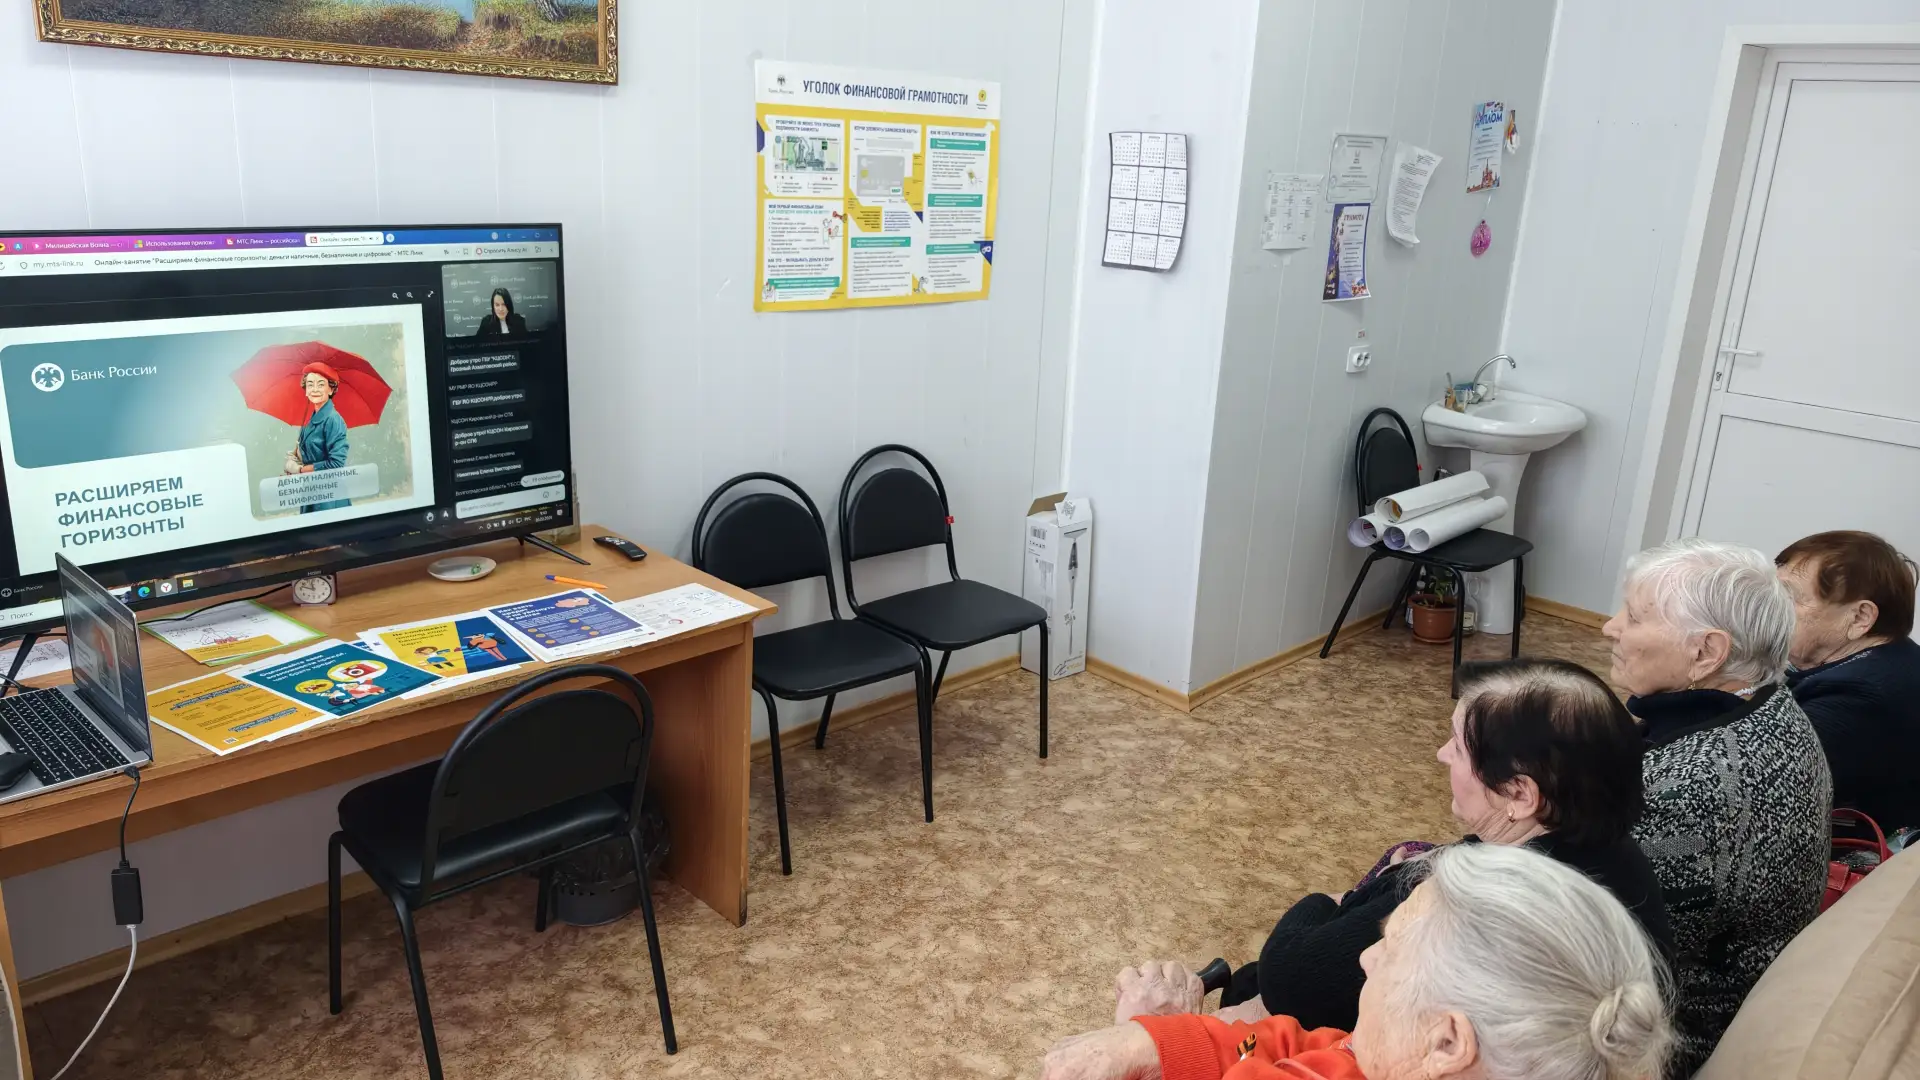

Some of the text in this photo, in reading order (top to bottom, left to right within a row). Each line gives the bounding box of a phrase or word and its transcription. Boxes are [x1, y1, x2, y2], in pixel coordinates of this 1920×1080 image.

[803, 80, 969, 106] УГОЛОК ФИНАНСОВОЙ ГРАМОТНОСТИ
[33, 260, 84, 268] my.mts-link.ru
[94, 258, 151, 266] Онлайн-занятие
[71, 366, 157, 381] Банк России
[278, 476, 310, 487] ДЕНЬГИ
[54, 476, 184, 507] РАСШИРЯЕМ
[278, 482, 338, 496] БЕЗНАЛИЧНЫЕ
[288, 493, 334, 506] ЦИФРОВЫЕ
[58, 493, 204, 527] ФИНАНСОВЫЕ
[61, 516, 185, 548] ГОРИЗОНТЫ
[10, 612, 34, 620] Поиск
